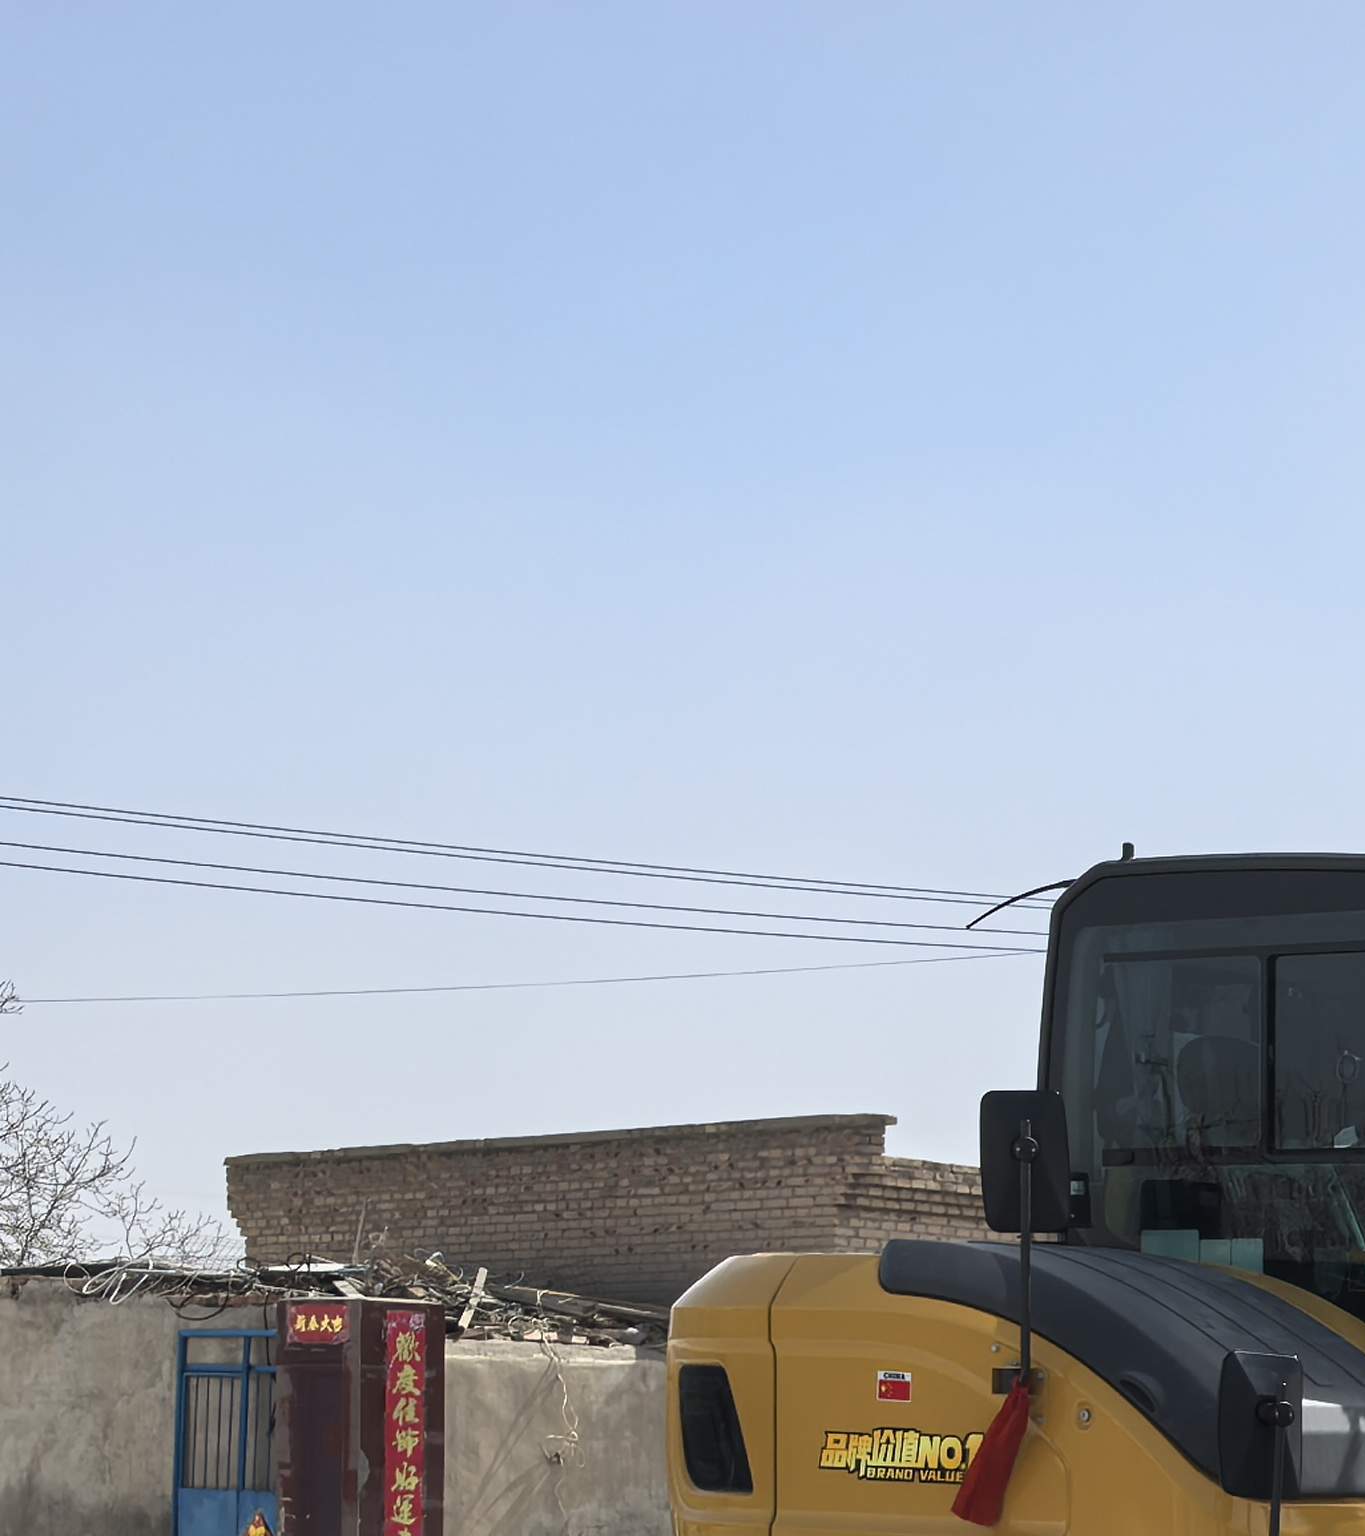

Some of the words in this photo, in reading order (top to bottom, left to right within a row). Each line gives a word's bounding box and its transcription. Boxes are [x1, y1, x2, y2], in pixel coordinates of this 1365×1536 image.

[294, 1313, 344, 1333] 新春大吉
[866, 1467, 913, 1479] BRAND
[920, 1469, 964, 1482] VALUE
